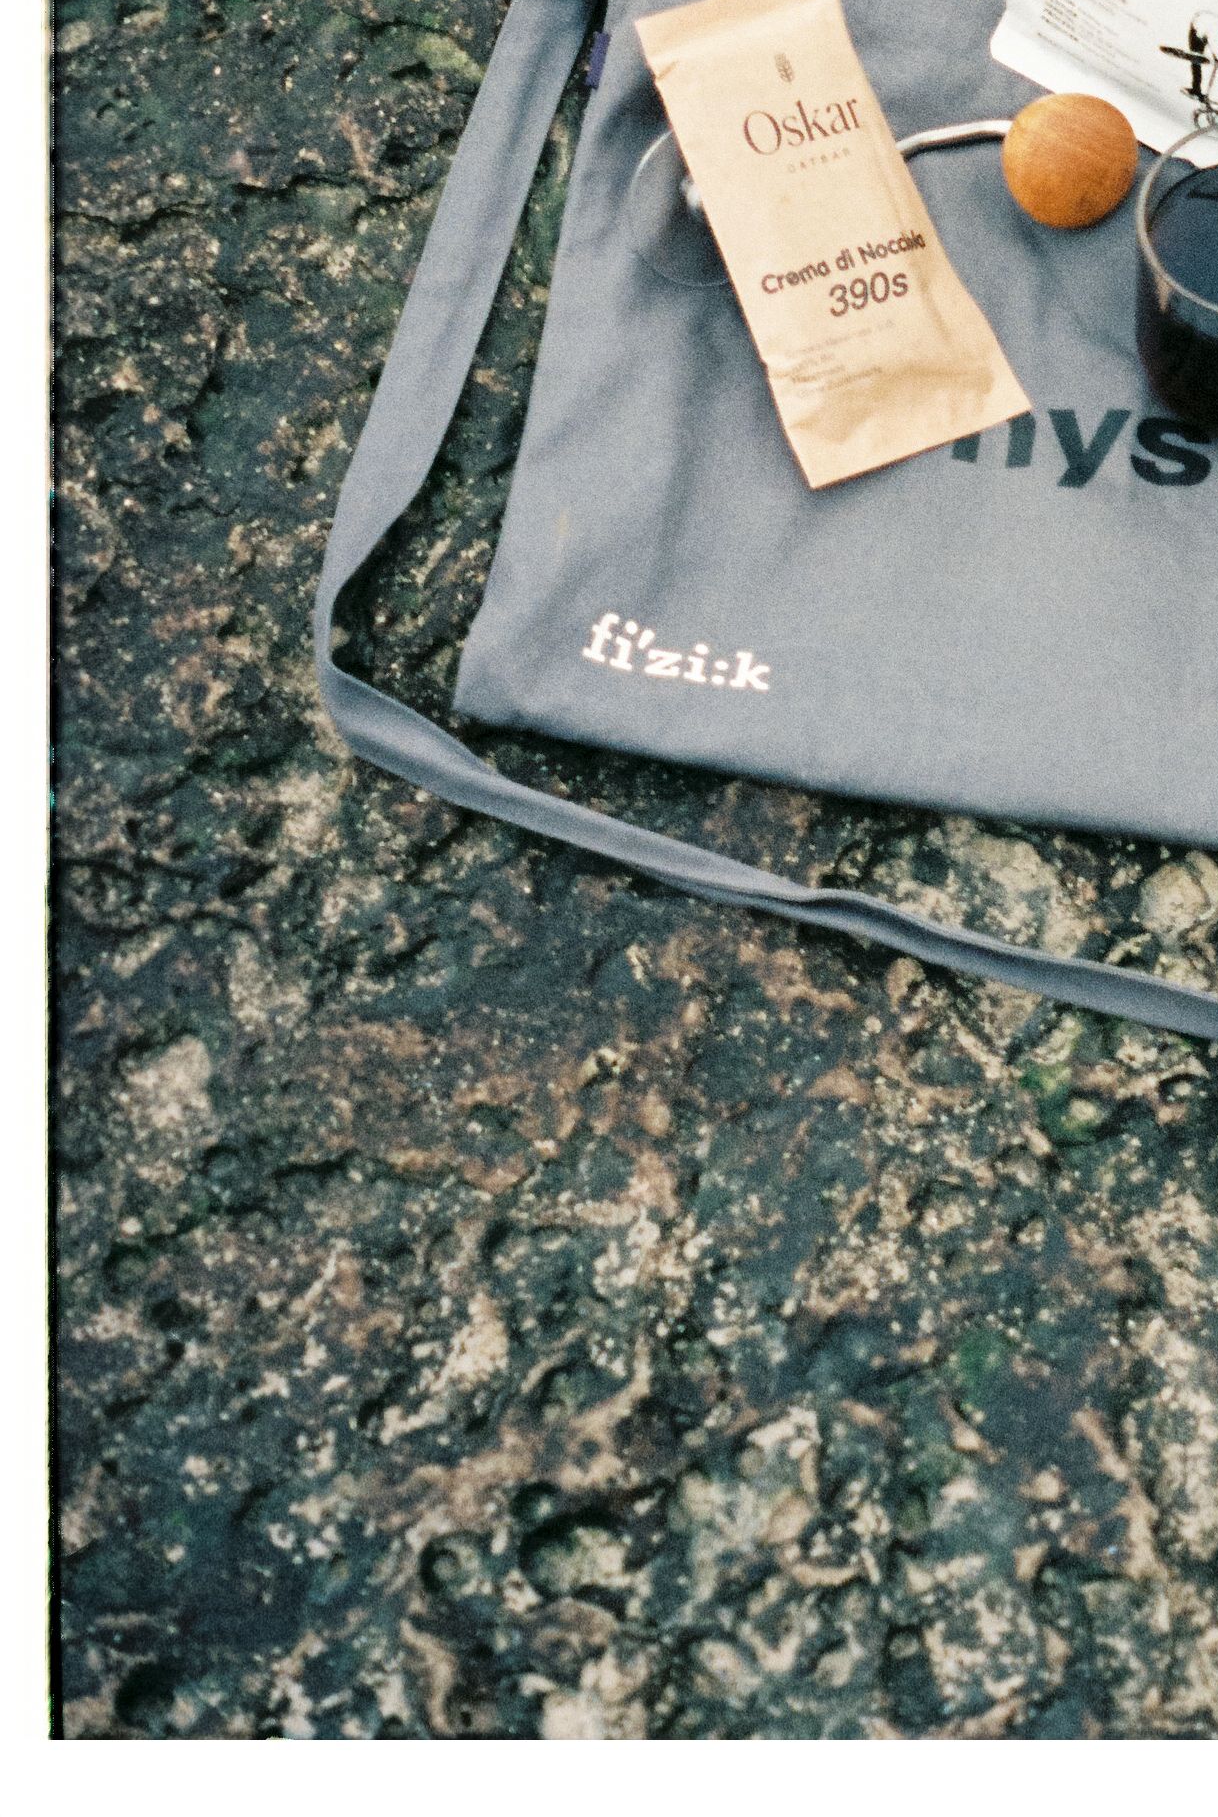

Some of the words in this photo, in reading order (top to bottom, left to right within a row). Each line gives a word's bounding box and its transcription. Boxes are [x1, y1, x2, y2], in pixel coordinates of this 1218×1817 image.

[743, 96, 861, 155] Oskar
[761, 259, 831, 295] Crema
[836, 247, 856, 270] di
[829, 270, 909, 318] 390s
